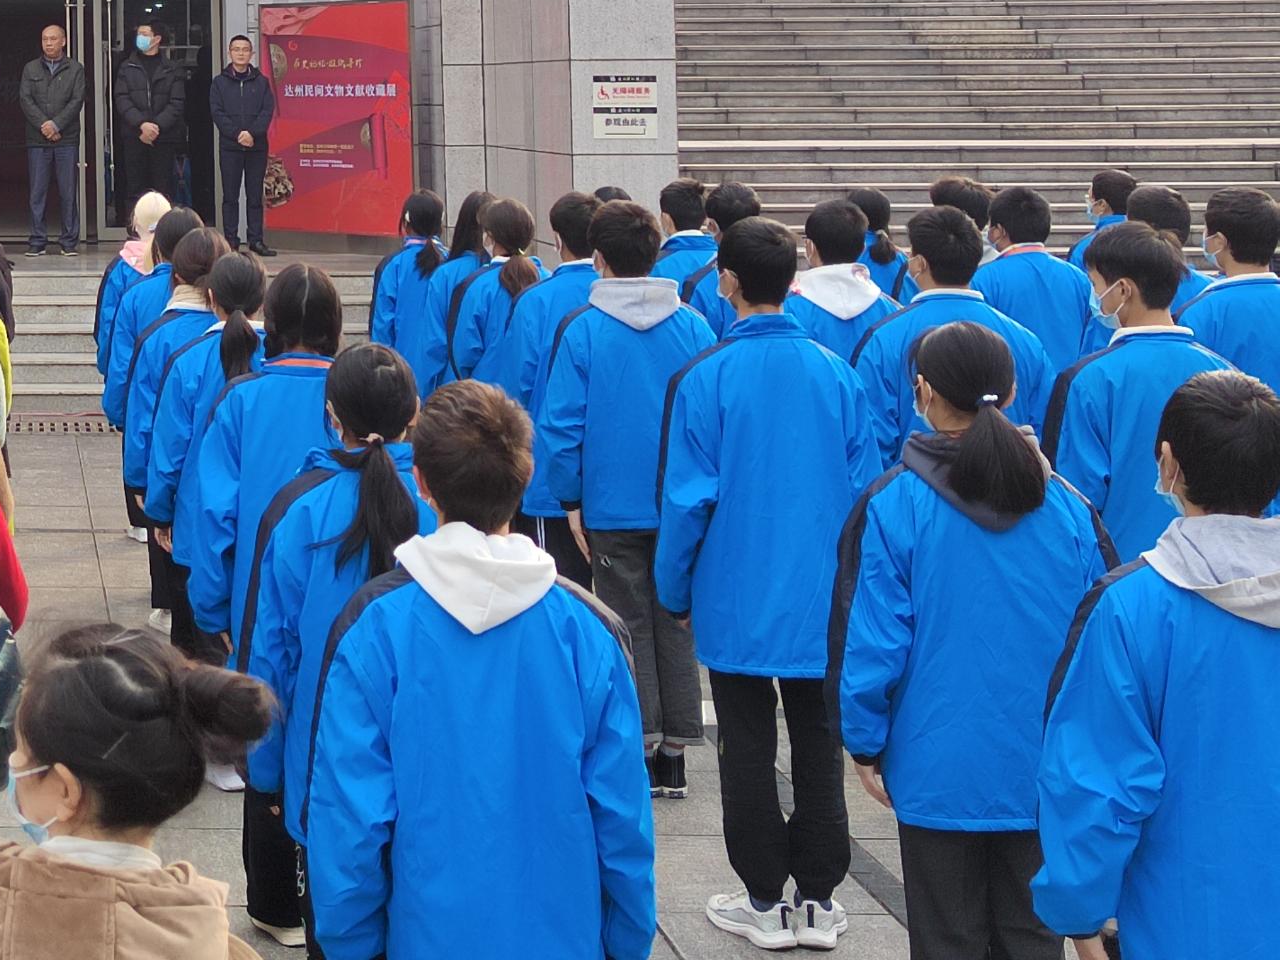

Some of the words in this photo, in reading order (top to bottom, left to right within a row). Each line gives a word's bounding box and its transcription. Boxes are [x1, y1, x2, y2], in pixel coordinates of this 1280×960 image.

[284, 83, 396, 97] 达州民间文物文献收藏展
